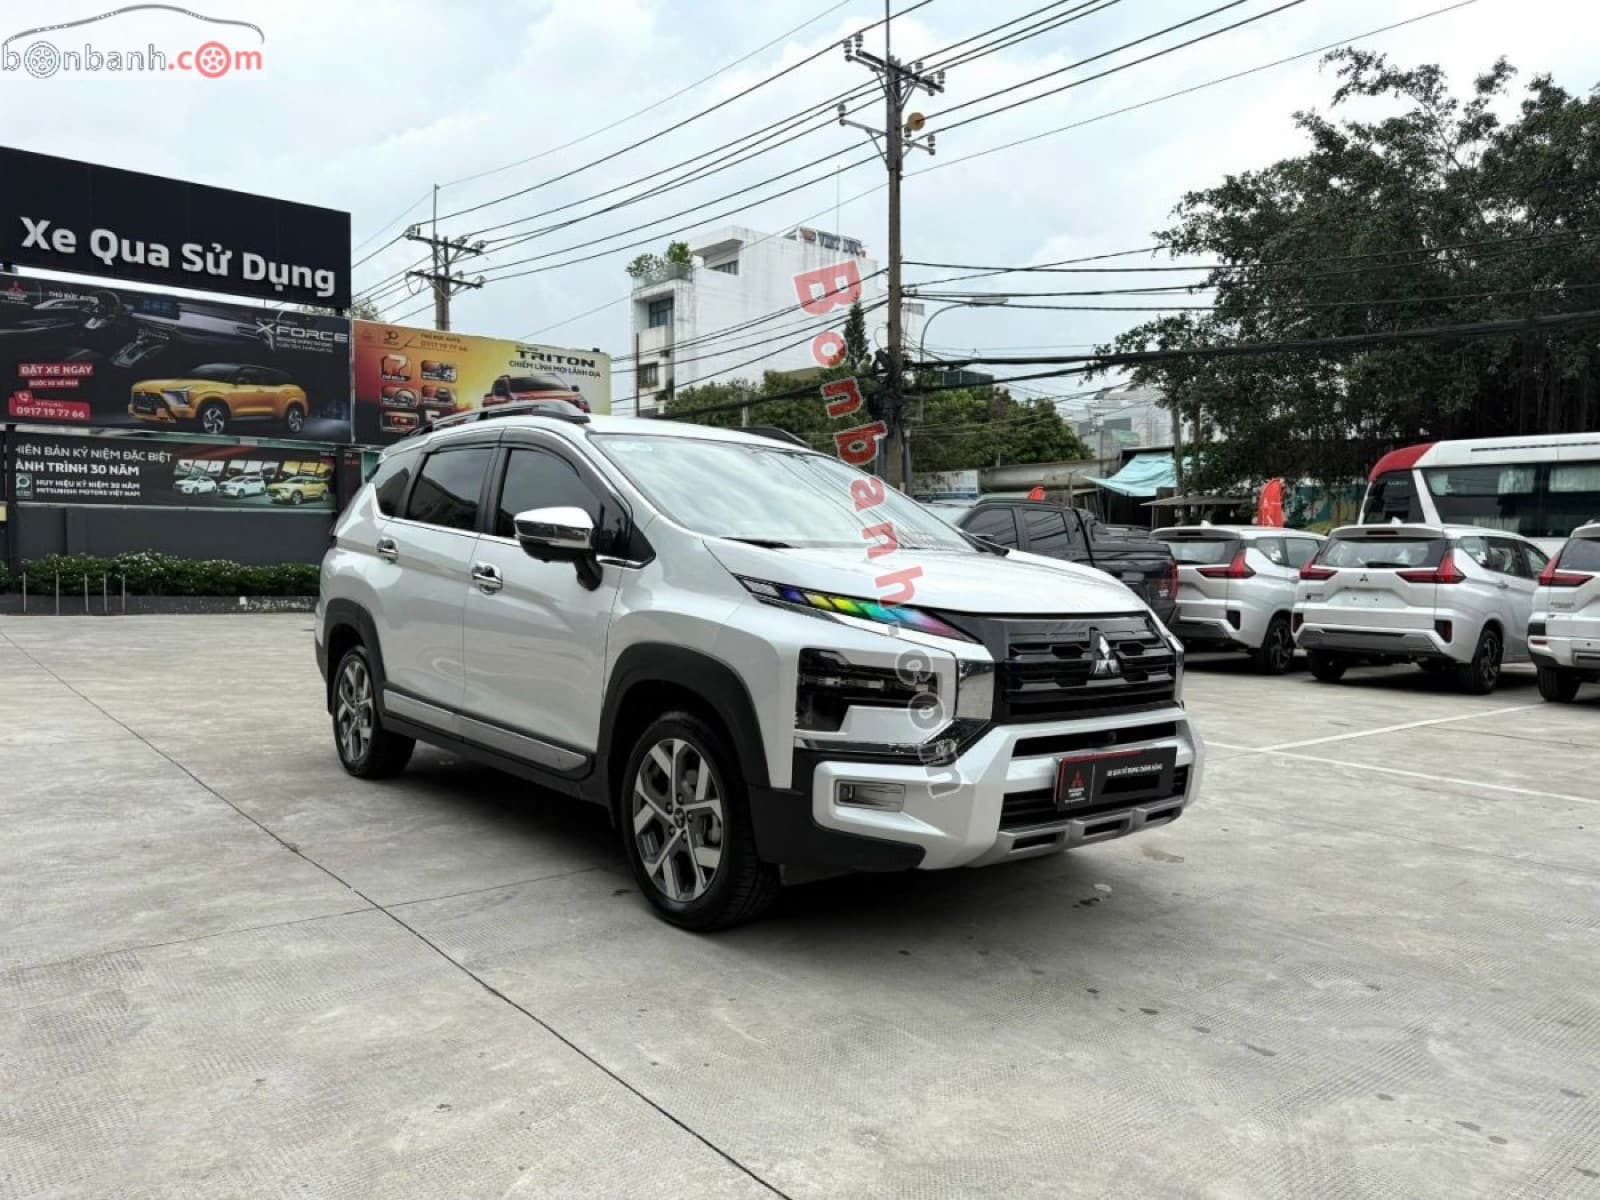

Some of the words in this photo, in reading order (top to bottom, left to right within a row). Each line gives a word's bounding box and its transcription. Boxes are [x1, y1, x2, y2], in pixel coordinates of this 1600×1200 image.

[20, 216, 76, 253] Xe
[90, 228, 170, 266] Qua
[182, 243, 232, 277] Sử
[242, 252, 336, 298] Dụng
[256, 319, 348, 351] XFORCE
[515, 350, 596, 368] TRITON
[46, 366, 60, 374] XE
[63, 366, 93, 375] NGAY
[16, 406, 41, 416] 0917
[43, 407, 55, 416] 19
[57, 409, 70, 417] 77
[71, 410, 85, 418] 66
[44, 444, 70, 457] BẢN
[91, 447, 121, 461] NIỆM
[123, 449, 146, 463] ĐẶC
[147, 450, 173, 463] BIỆT
[46, 460, 88, 474] TRÌNH
[90, 464, 107, 474] 30
[109, 464, 139, 476] NĂM
